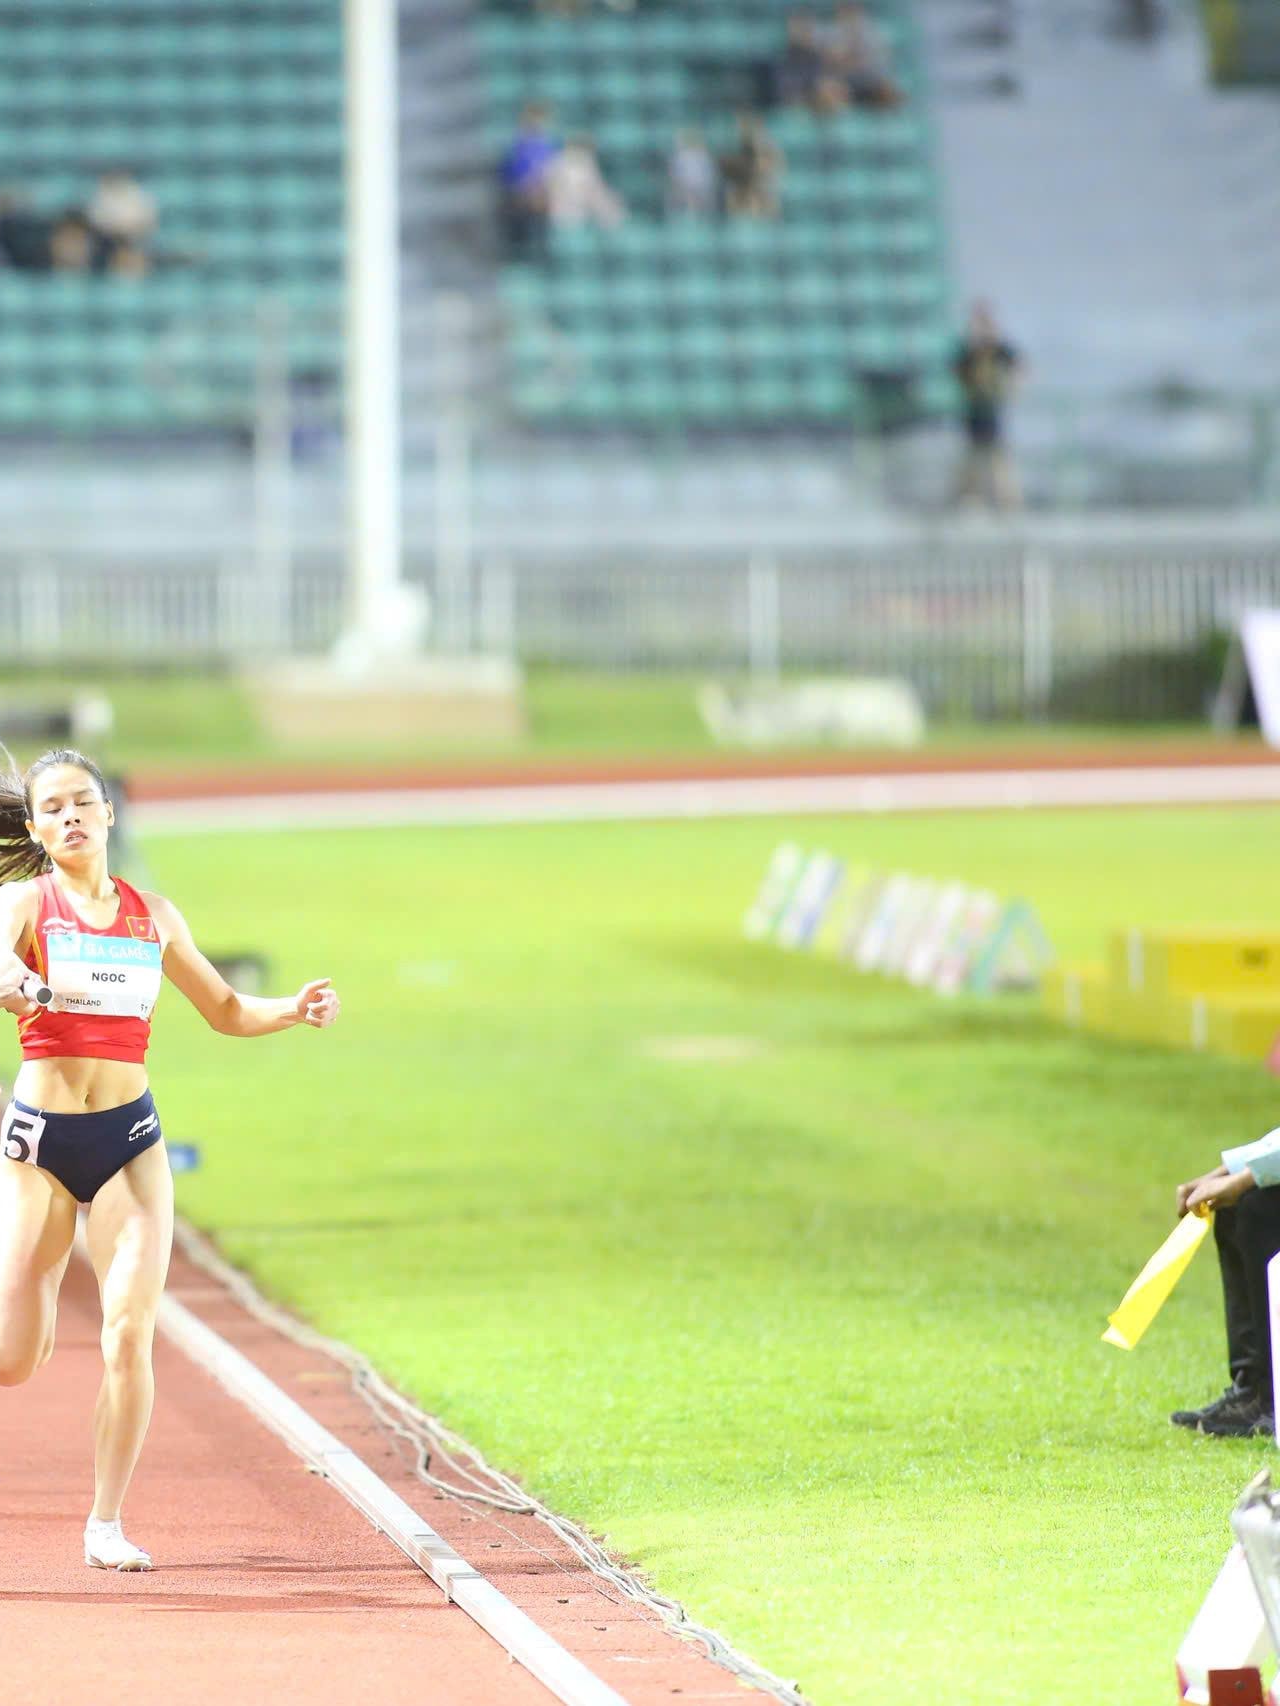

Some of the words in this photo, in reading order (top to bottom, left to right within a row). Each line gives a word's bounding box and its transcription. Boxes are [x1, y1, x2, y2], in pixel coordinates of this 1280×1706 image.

[91, 972, 126, 983] NGOC
[65, 998, 102, 1007] THAILAND
[4, 1118, 33, 1163] 5
